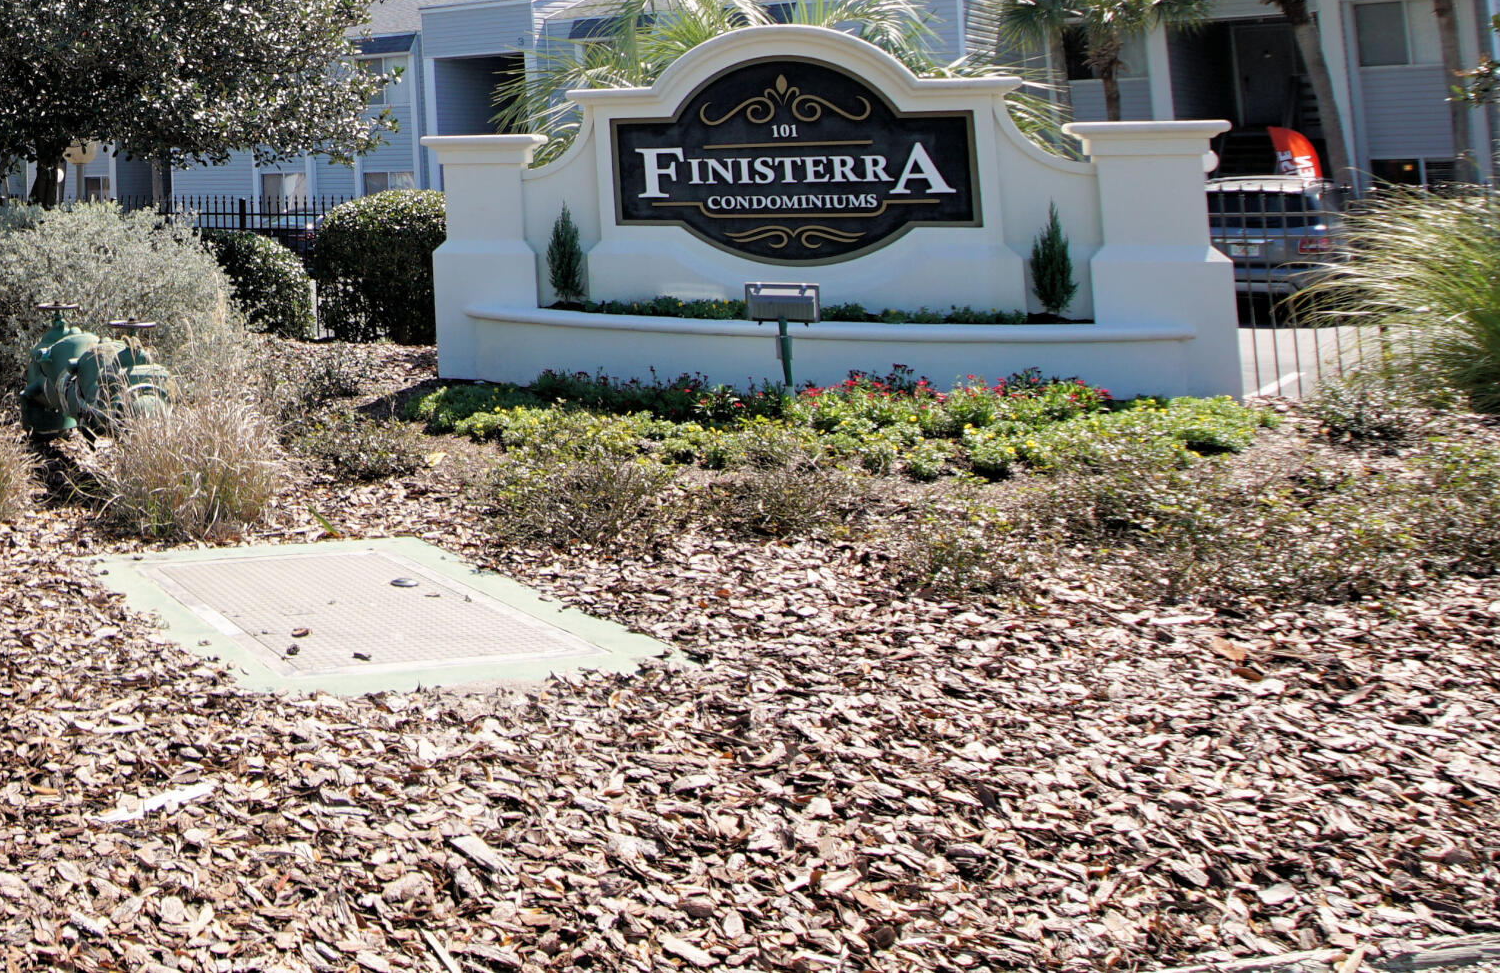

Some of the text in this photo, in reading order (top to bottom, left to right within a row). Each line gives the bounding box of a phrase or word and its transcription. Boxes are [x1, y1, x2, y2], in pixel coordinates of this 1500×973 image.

[771, 123, 798, 139] 101
[634, 141, 957, 199] FINISTERRA
[707, 193, 878, 210] CONDOMINIUMS
